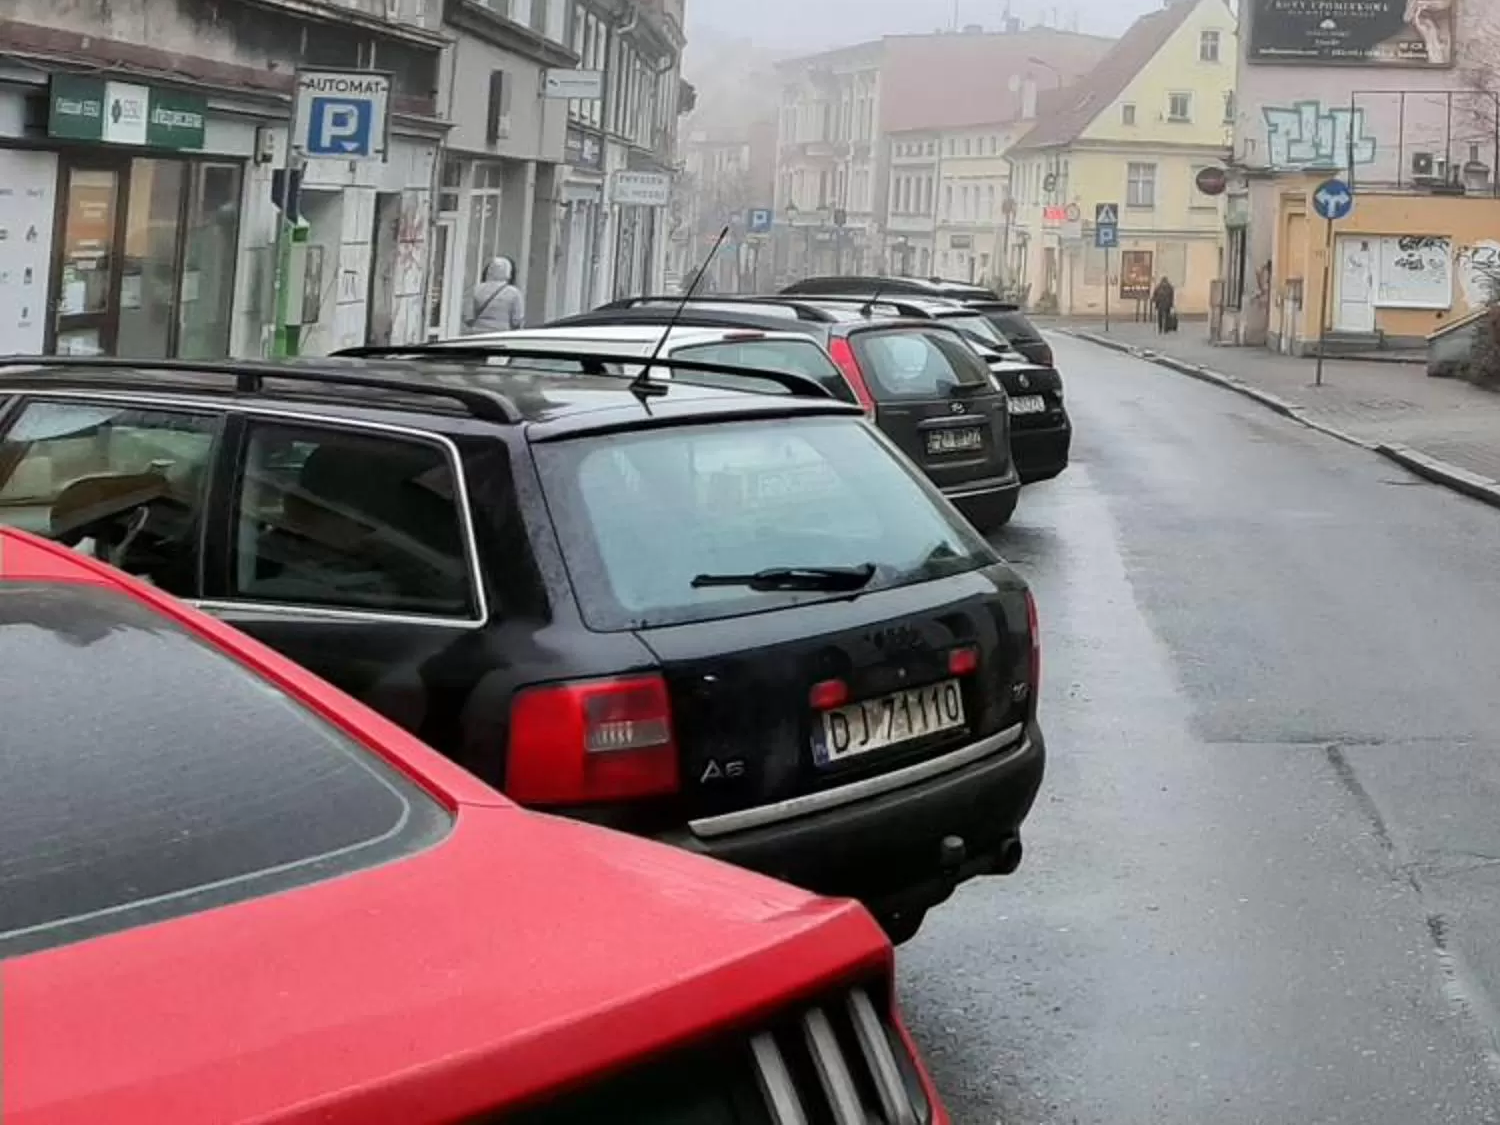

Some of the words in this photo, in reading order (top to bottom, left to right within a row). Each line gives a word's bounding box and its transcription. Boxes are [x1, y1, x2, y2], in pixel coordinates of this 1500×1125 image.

[308, 78, 380, 92] AUTOMAT
[320, 103, 359, 148] P
[752, 211, 767, 228] P
[1100, 228, 1113, 244] P
